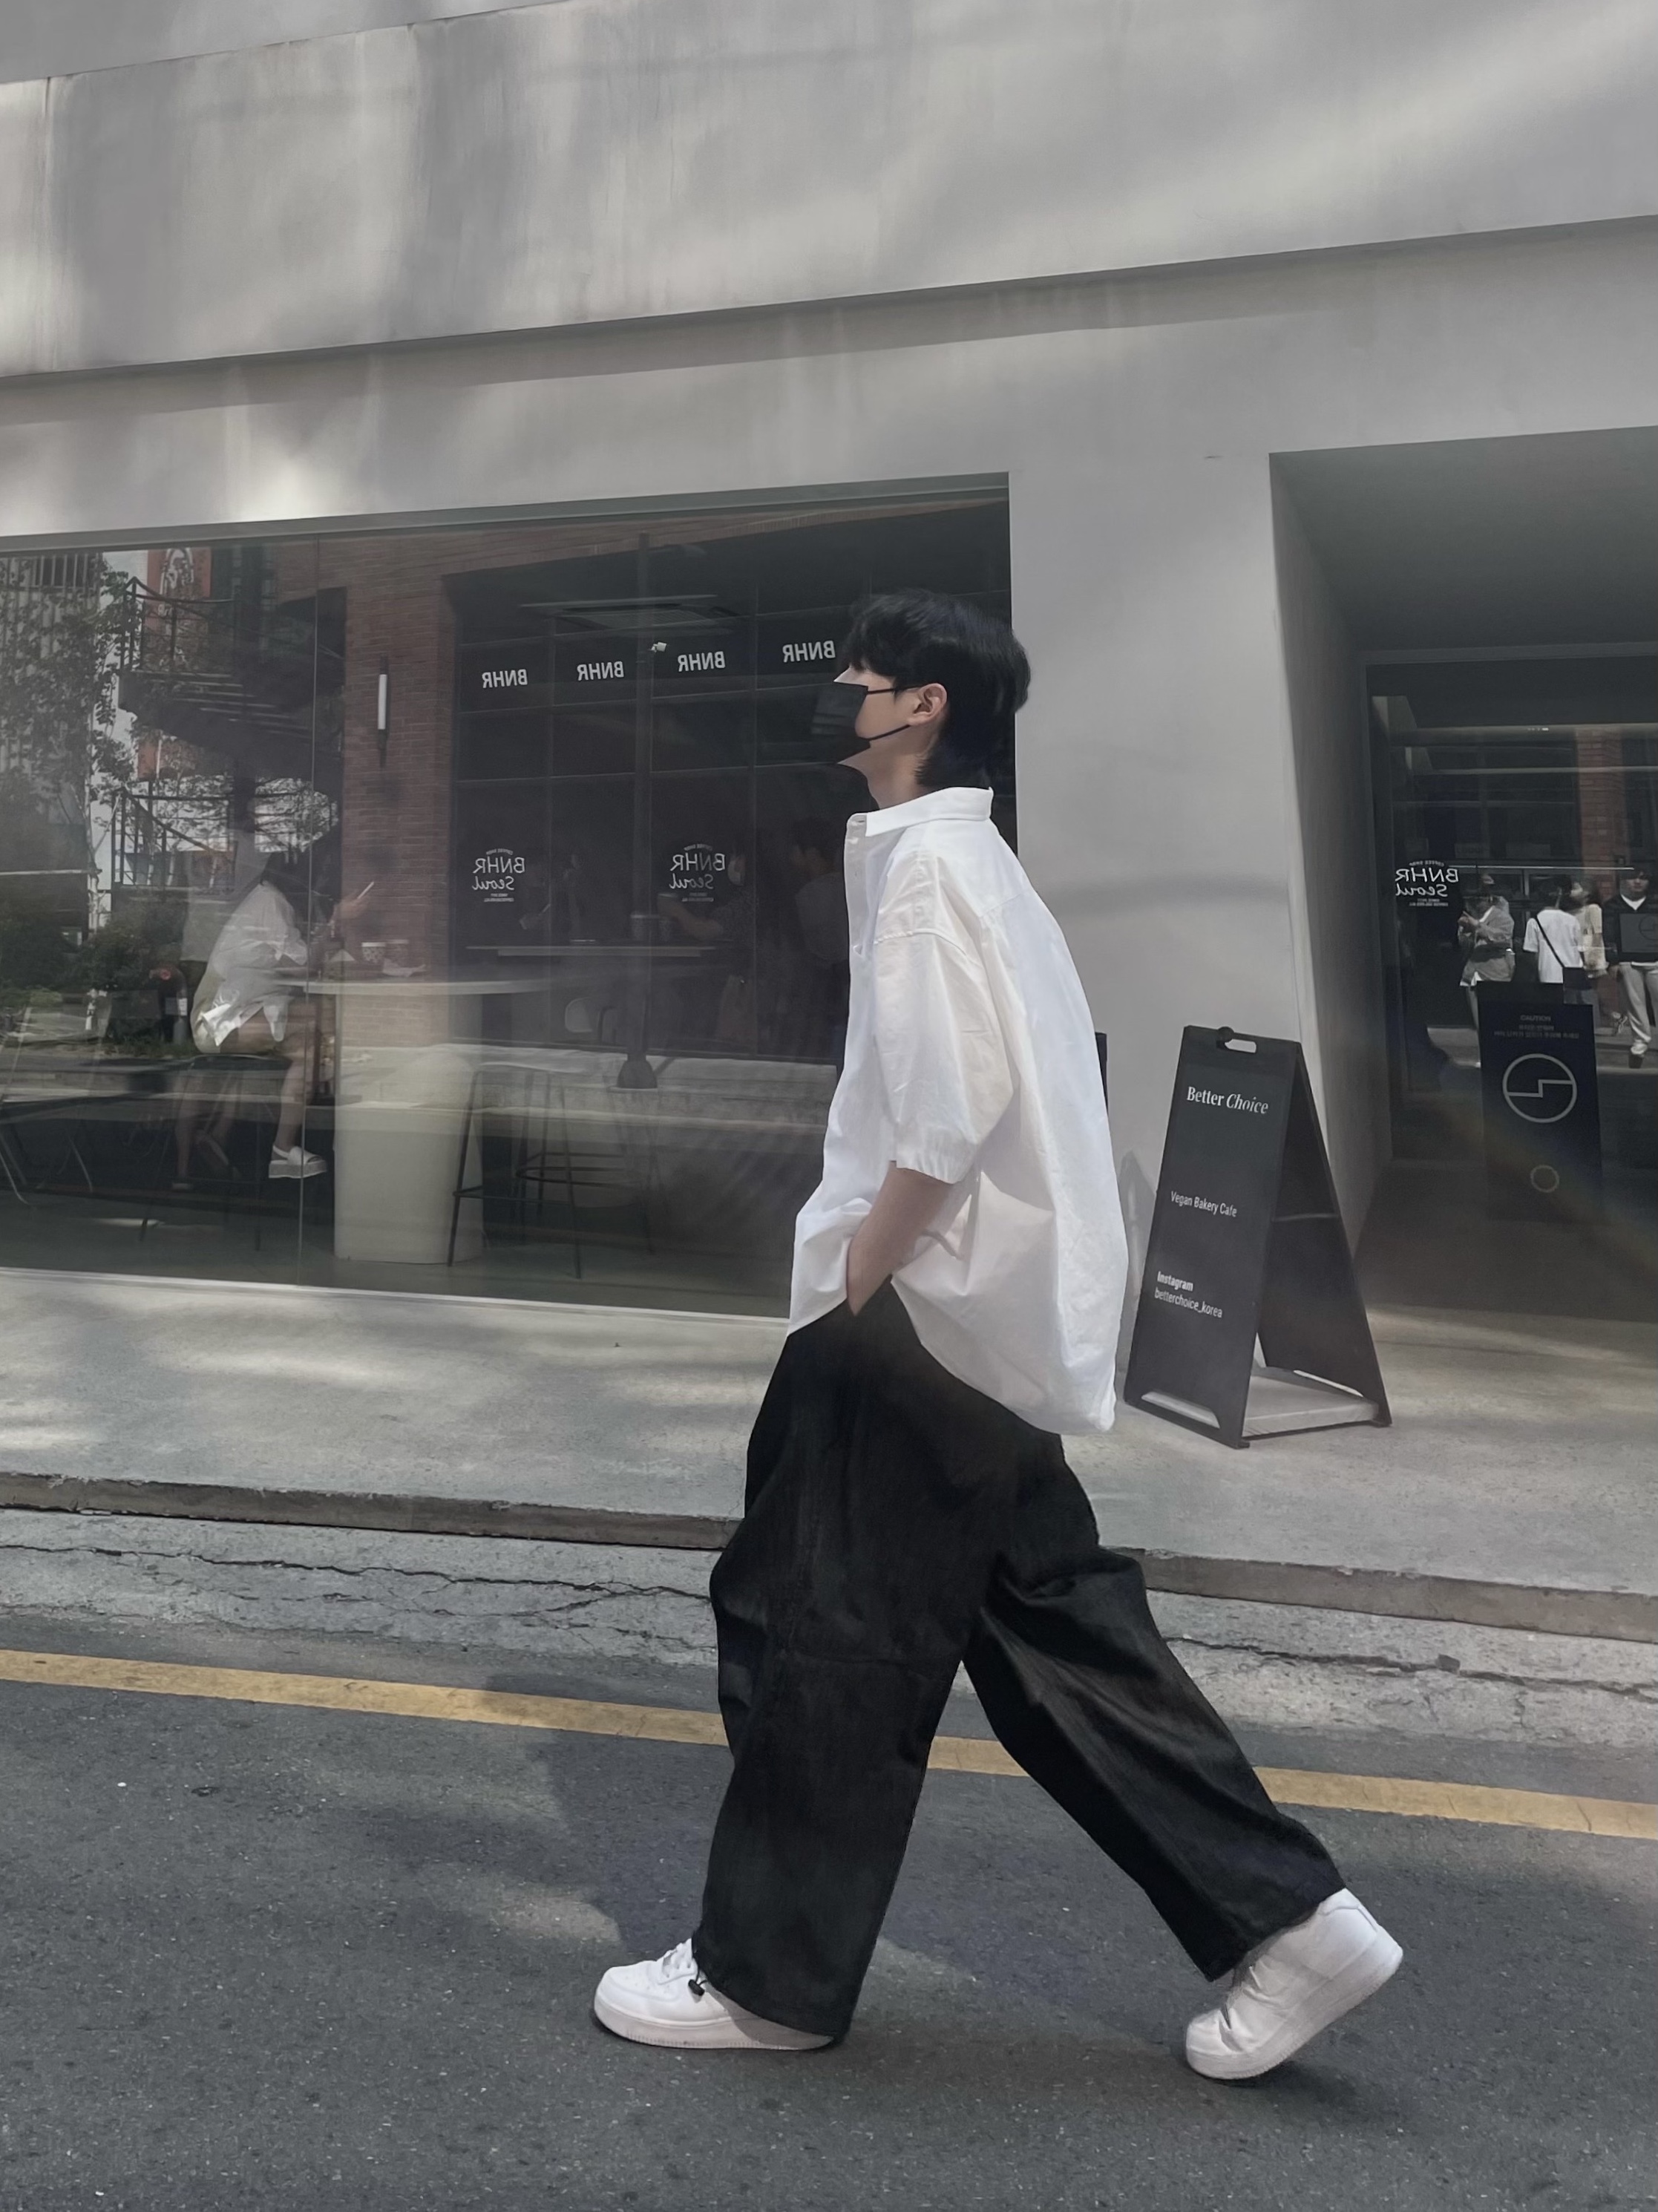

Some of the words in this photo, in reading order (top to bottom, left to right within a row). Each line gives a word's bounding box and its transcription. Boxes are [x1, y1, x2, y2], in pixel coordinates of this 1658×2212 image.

[1186, 1086, 1225, 1106] Better
[1226, 1093, 1268, 1114] Choice
[1170, 1191, 1193, 1207] Vegan
[1194, 1197, 1219, 1216] Bakery
[1219, 1202, 1237, 1217] Cafe
[1157, 1270, 1193, 1292] Instagram
[1154, 1286, 1223, 1318] betterchoice_korea
